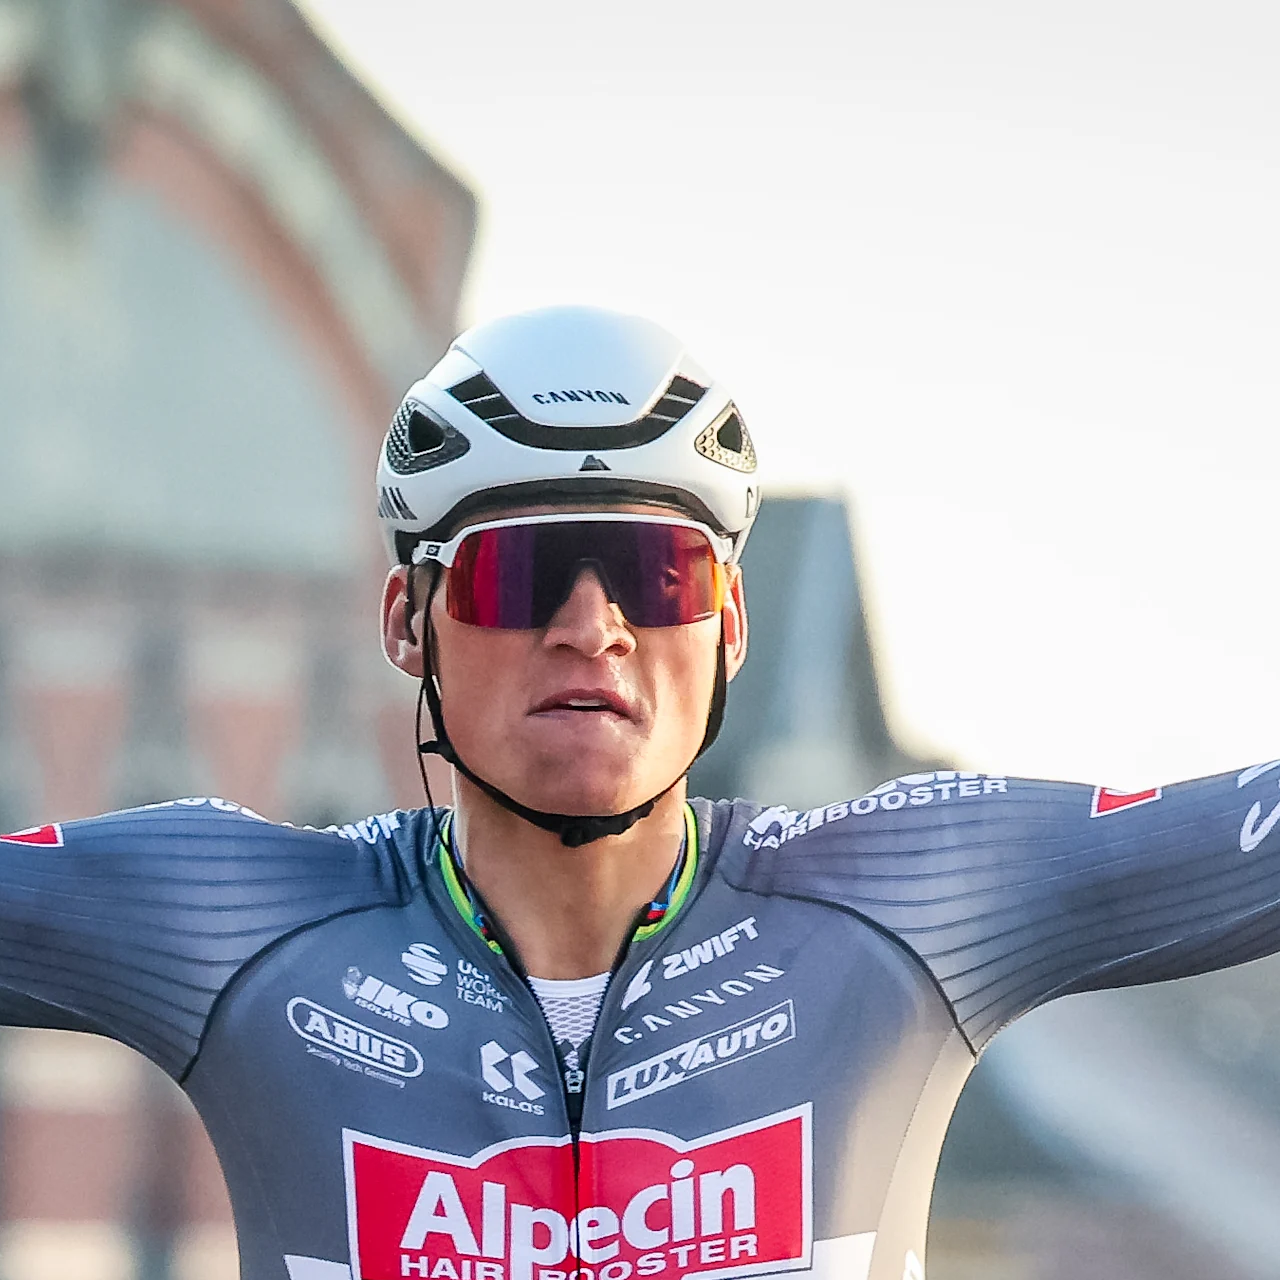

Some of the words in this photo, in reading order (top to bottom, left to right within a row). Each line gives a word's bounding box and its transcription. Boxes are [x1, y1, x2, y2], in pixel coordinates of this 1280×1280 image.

[532, 389, 631, 405] CANYON
[826, 779, 1008, 823] BOOSTER
[663, 916, 760, 980] ZWIFT
[357, 975, 450, 1029] IKO
[457, 986, 504, 1013] TEAM
[614, 964, 785, 1044] CANYON
[304, 1009, 407, 1069] ABUS
[613, 1012, 789, 1100] LUXAUTO
